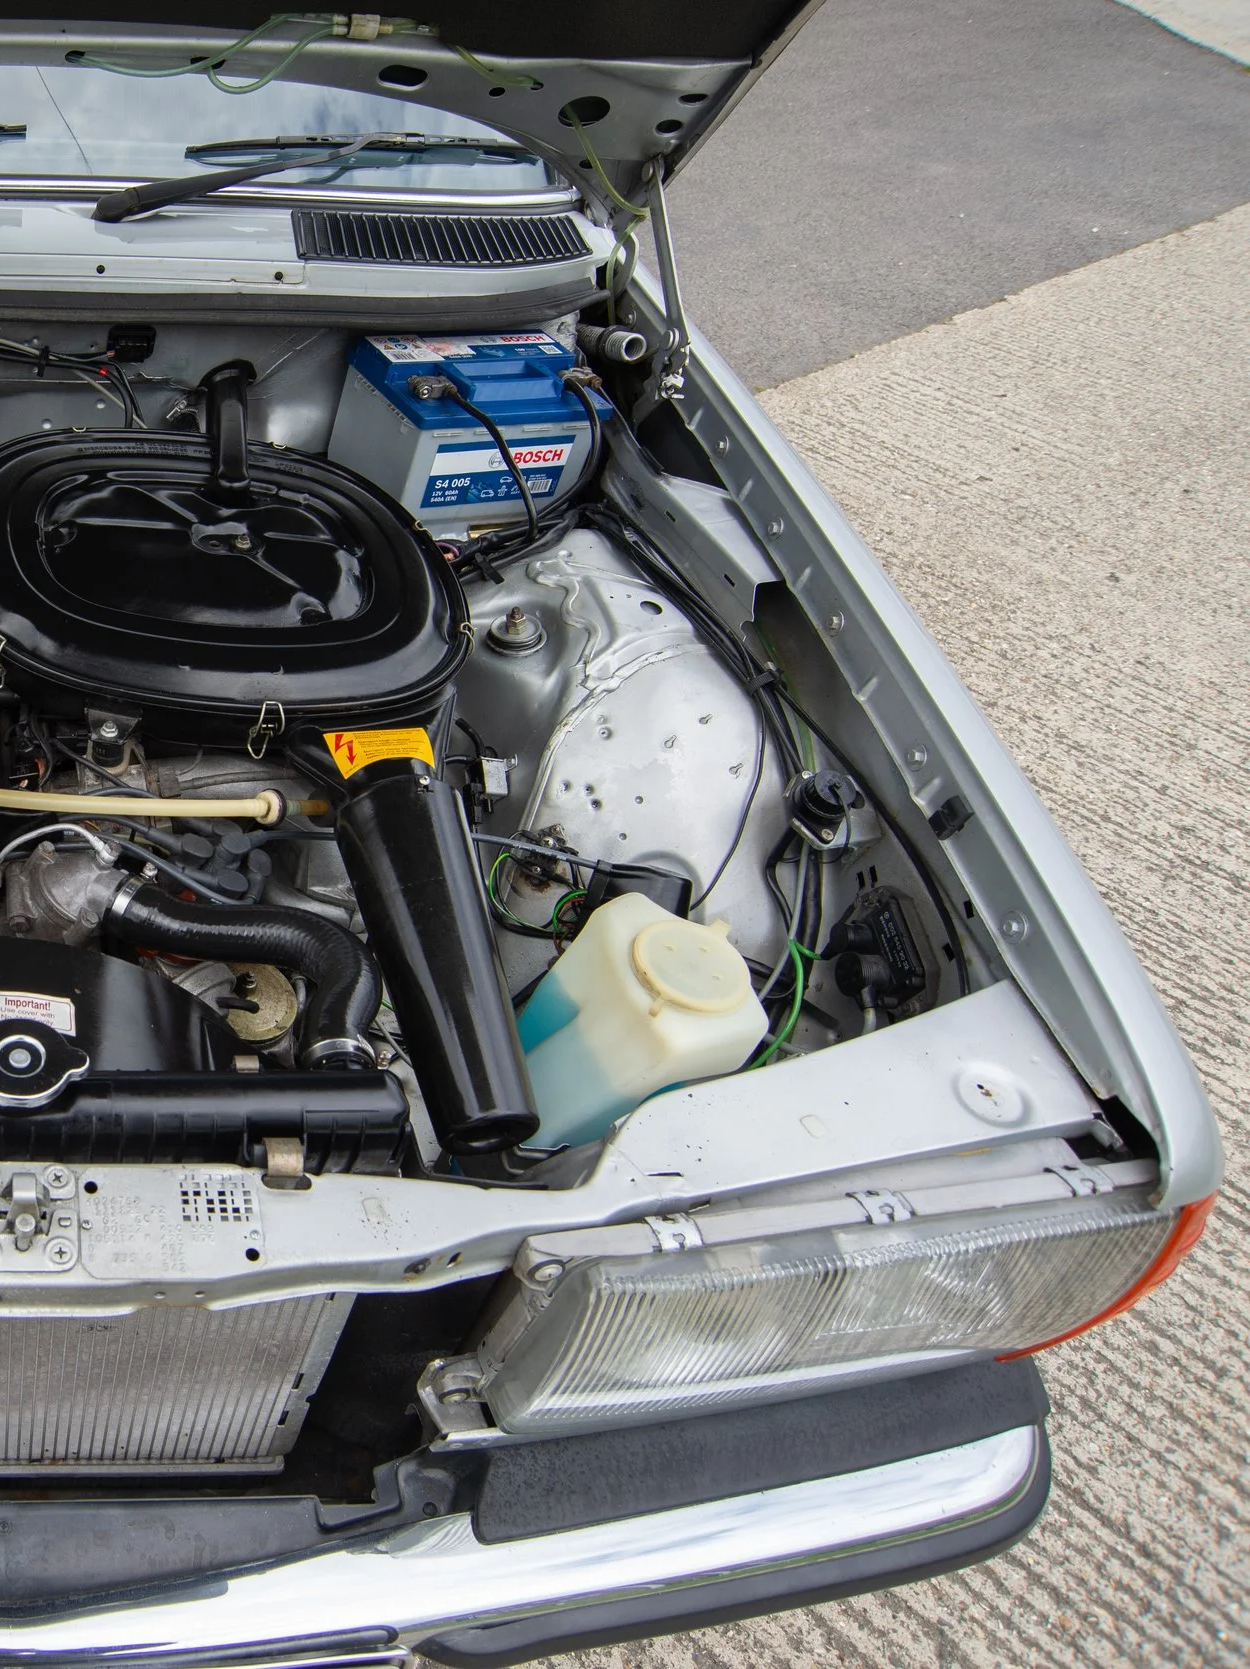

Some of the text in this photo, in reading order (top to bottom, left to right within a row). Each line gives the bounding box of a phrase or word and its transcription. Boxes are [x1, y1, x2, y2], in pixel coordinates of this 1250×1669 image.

[514, 449, 564, 464] BOSCH
[434, 477, 471, 489] S4 005
[4, 997, 51, 1011] Important!
